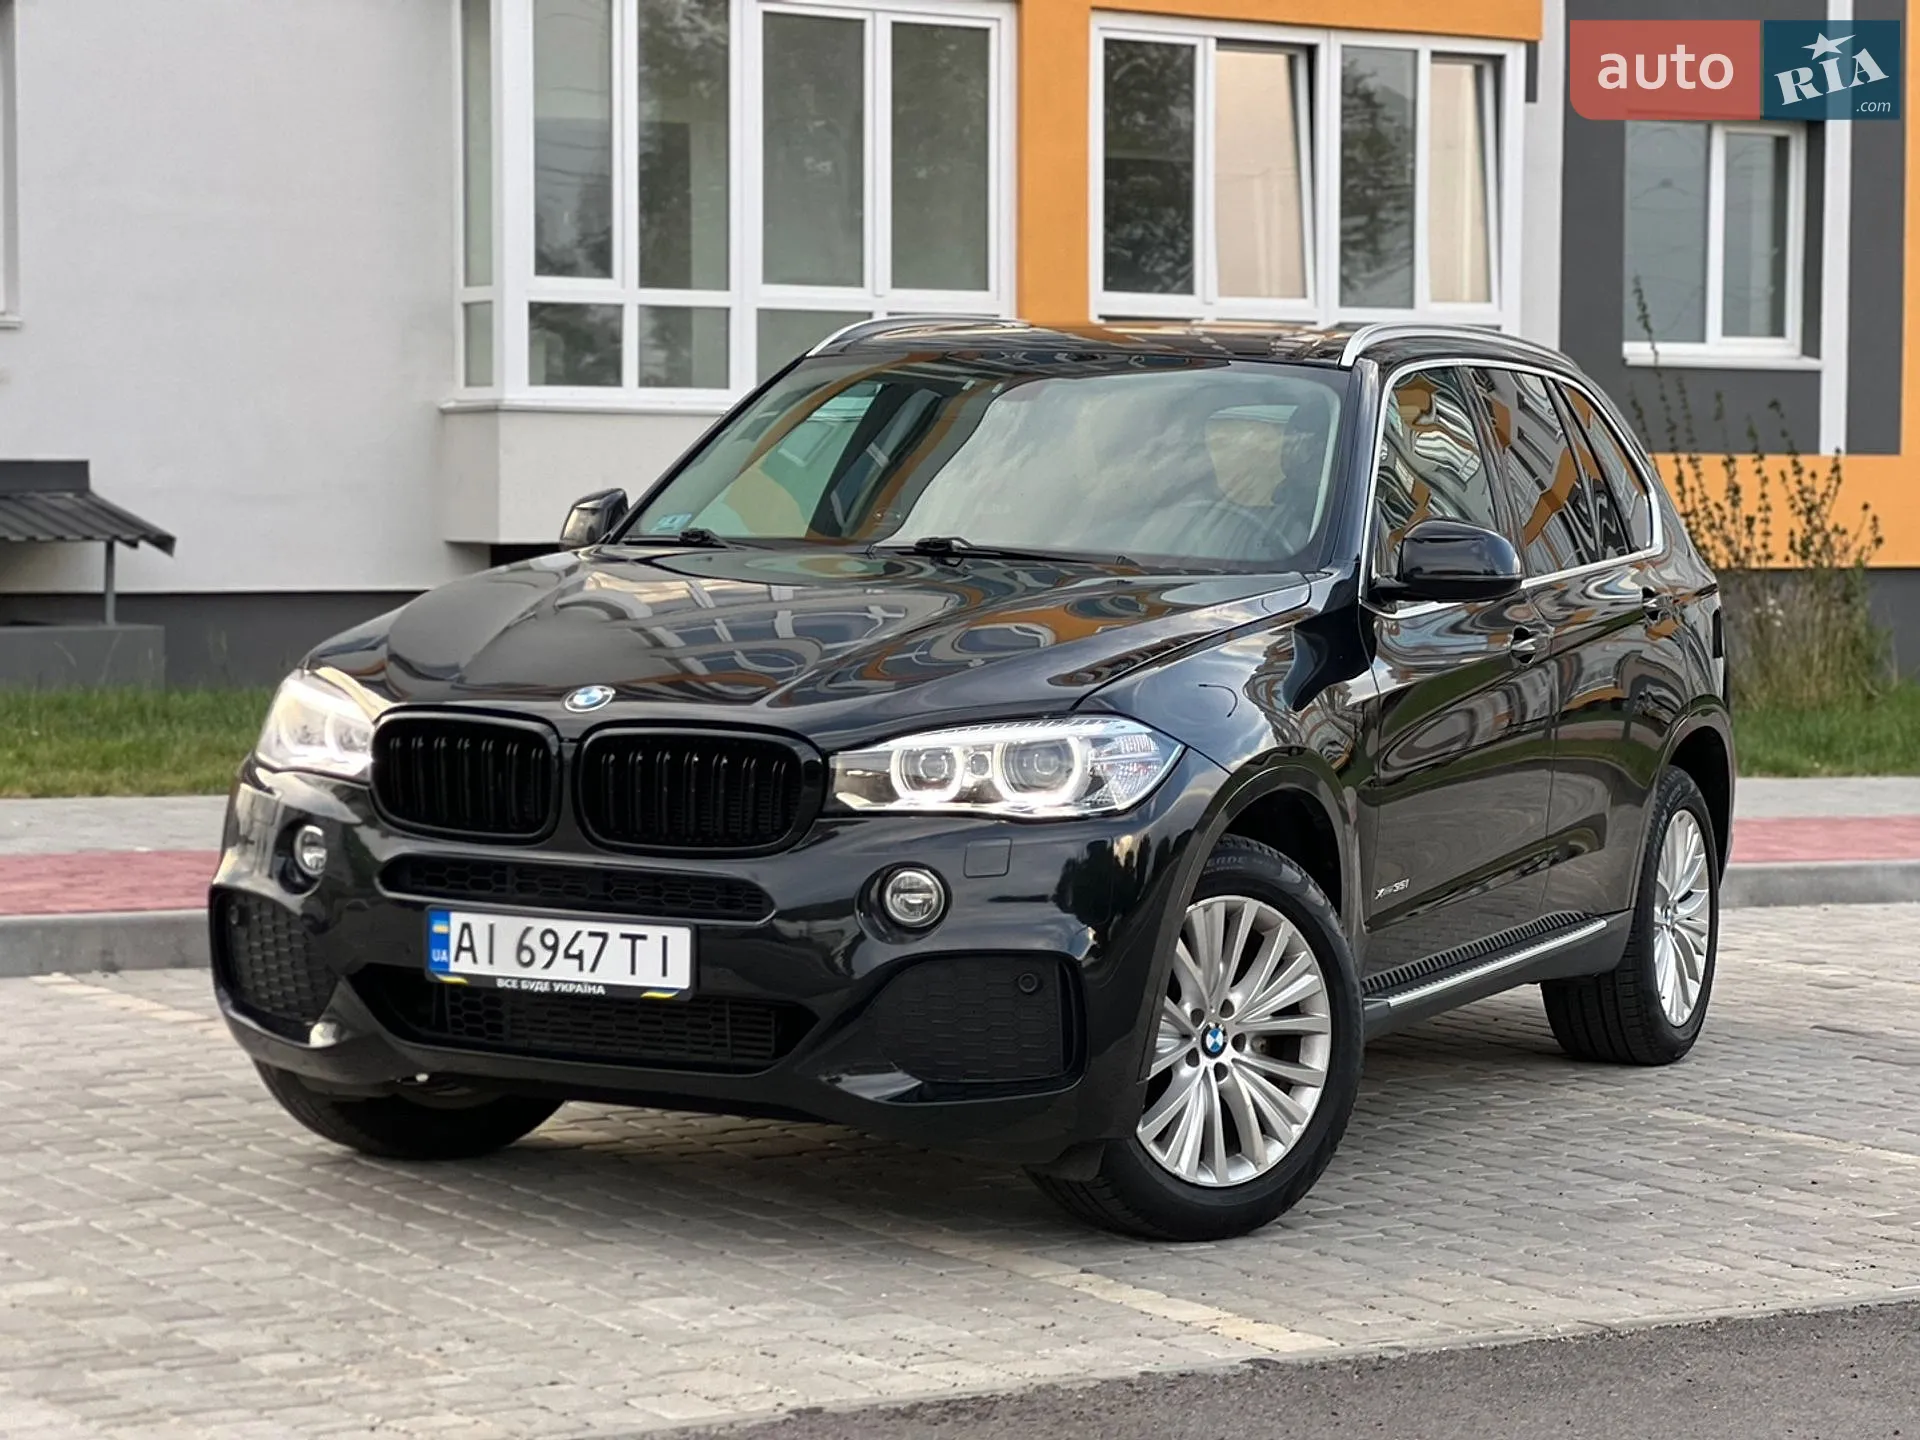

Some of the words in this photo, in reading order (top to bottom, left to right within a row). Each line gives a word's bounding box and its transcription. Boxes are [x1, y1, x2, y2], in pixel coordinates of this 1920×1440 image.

[432, 949, 449, 962] UA
[453, 921, 496, 966] AI
[515, 926, 610, 974] 6947
[619, 932, 669, 978] TI
[496, 977, 518, 989] ВСЕ
[520, 980, 550, 992] БУДЕ
[552, 981, 606, 995] УКРАЇНА
